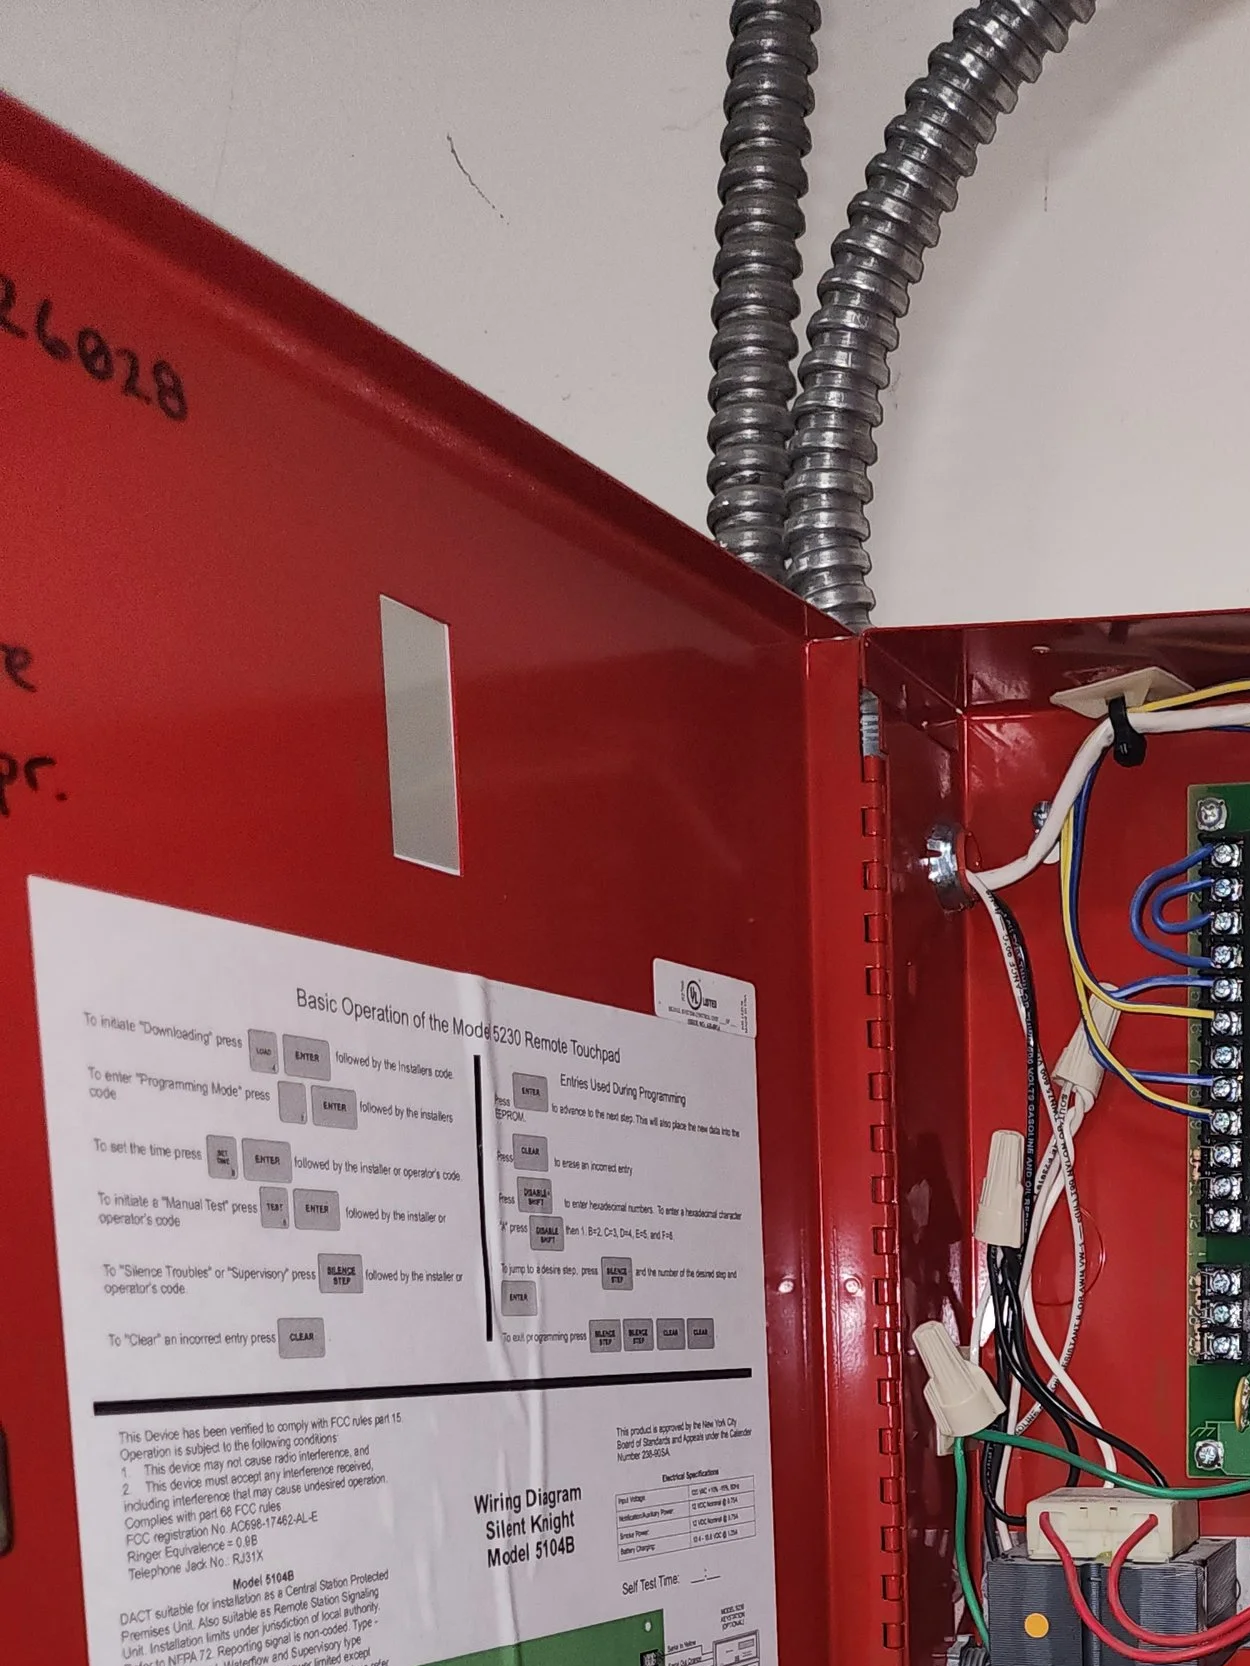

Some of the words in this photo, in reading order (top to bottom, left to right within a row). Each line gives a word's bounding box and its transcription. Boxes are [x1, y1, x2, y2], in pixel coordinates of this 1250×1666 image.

[296, 988, 338, 1014] Basic
[341, 997, 409, 1027] Operation
[412, 1012, 426, 1029] of
[428, 1013, 449, 1034] the
[492, 1024, 522, 1047] 5230
[524, 1030, 568, 1055] Remote
[569, 1038, 621, 1065] Touchpad
[560, 1072, 589, 1091] Entries
[589, 1078, 611, 1094] Used
[612, 1081, 638, 1101] During
[638, 1085, 687, 1108] Programming
[473, 1492, 522, 1515] Wiring
[525, 1486, 582, 1508] Diagram
[485, 1517, 527, 1541] Silent
[530, 1510, 575, 1534] Knight
[487, 1542, 530, 1568] Model
[535, 1535, 575, 1560] 5104B
[622, 1579, 639, 1596] Self
[639, 1577, 657, 1591] Test
[657, 1574, 680, 1588] Time:
